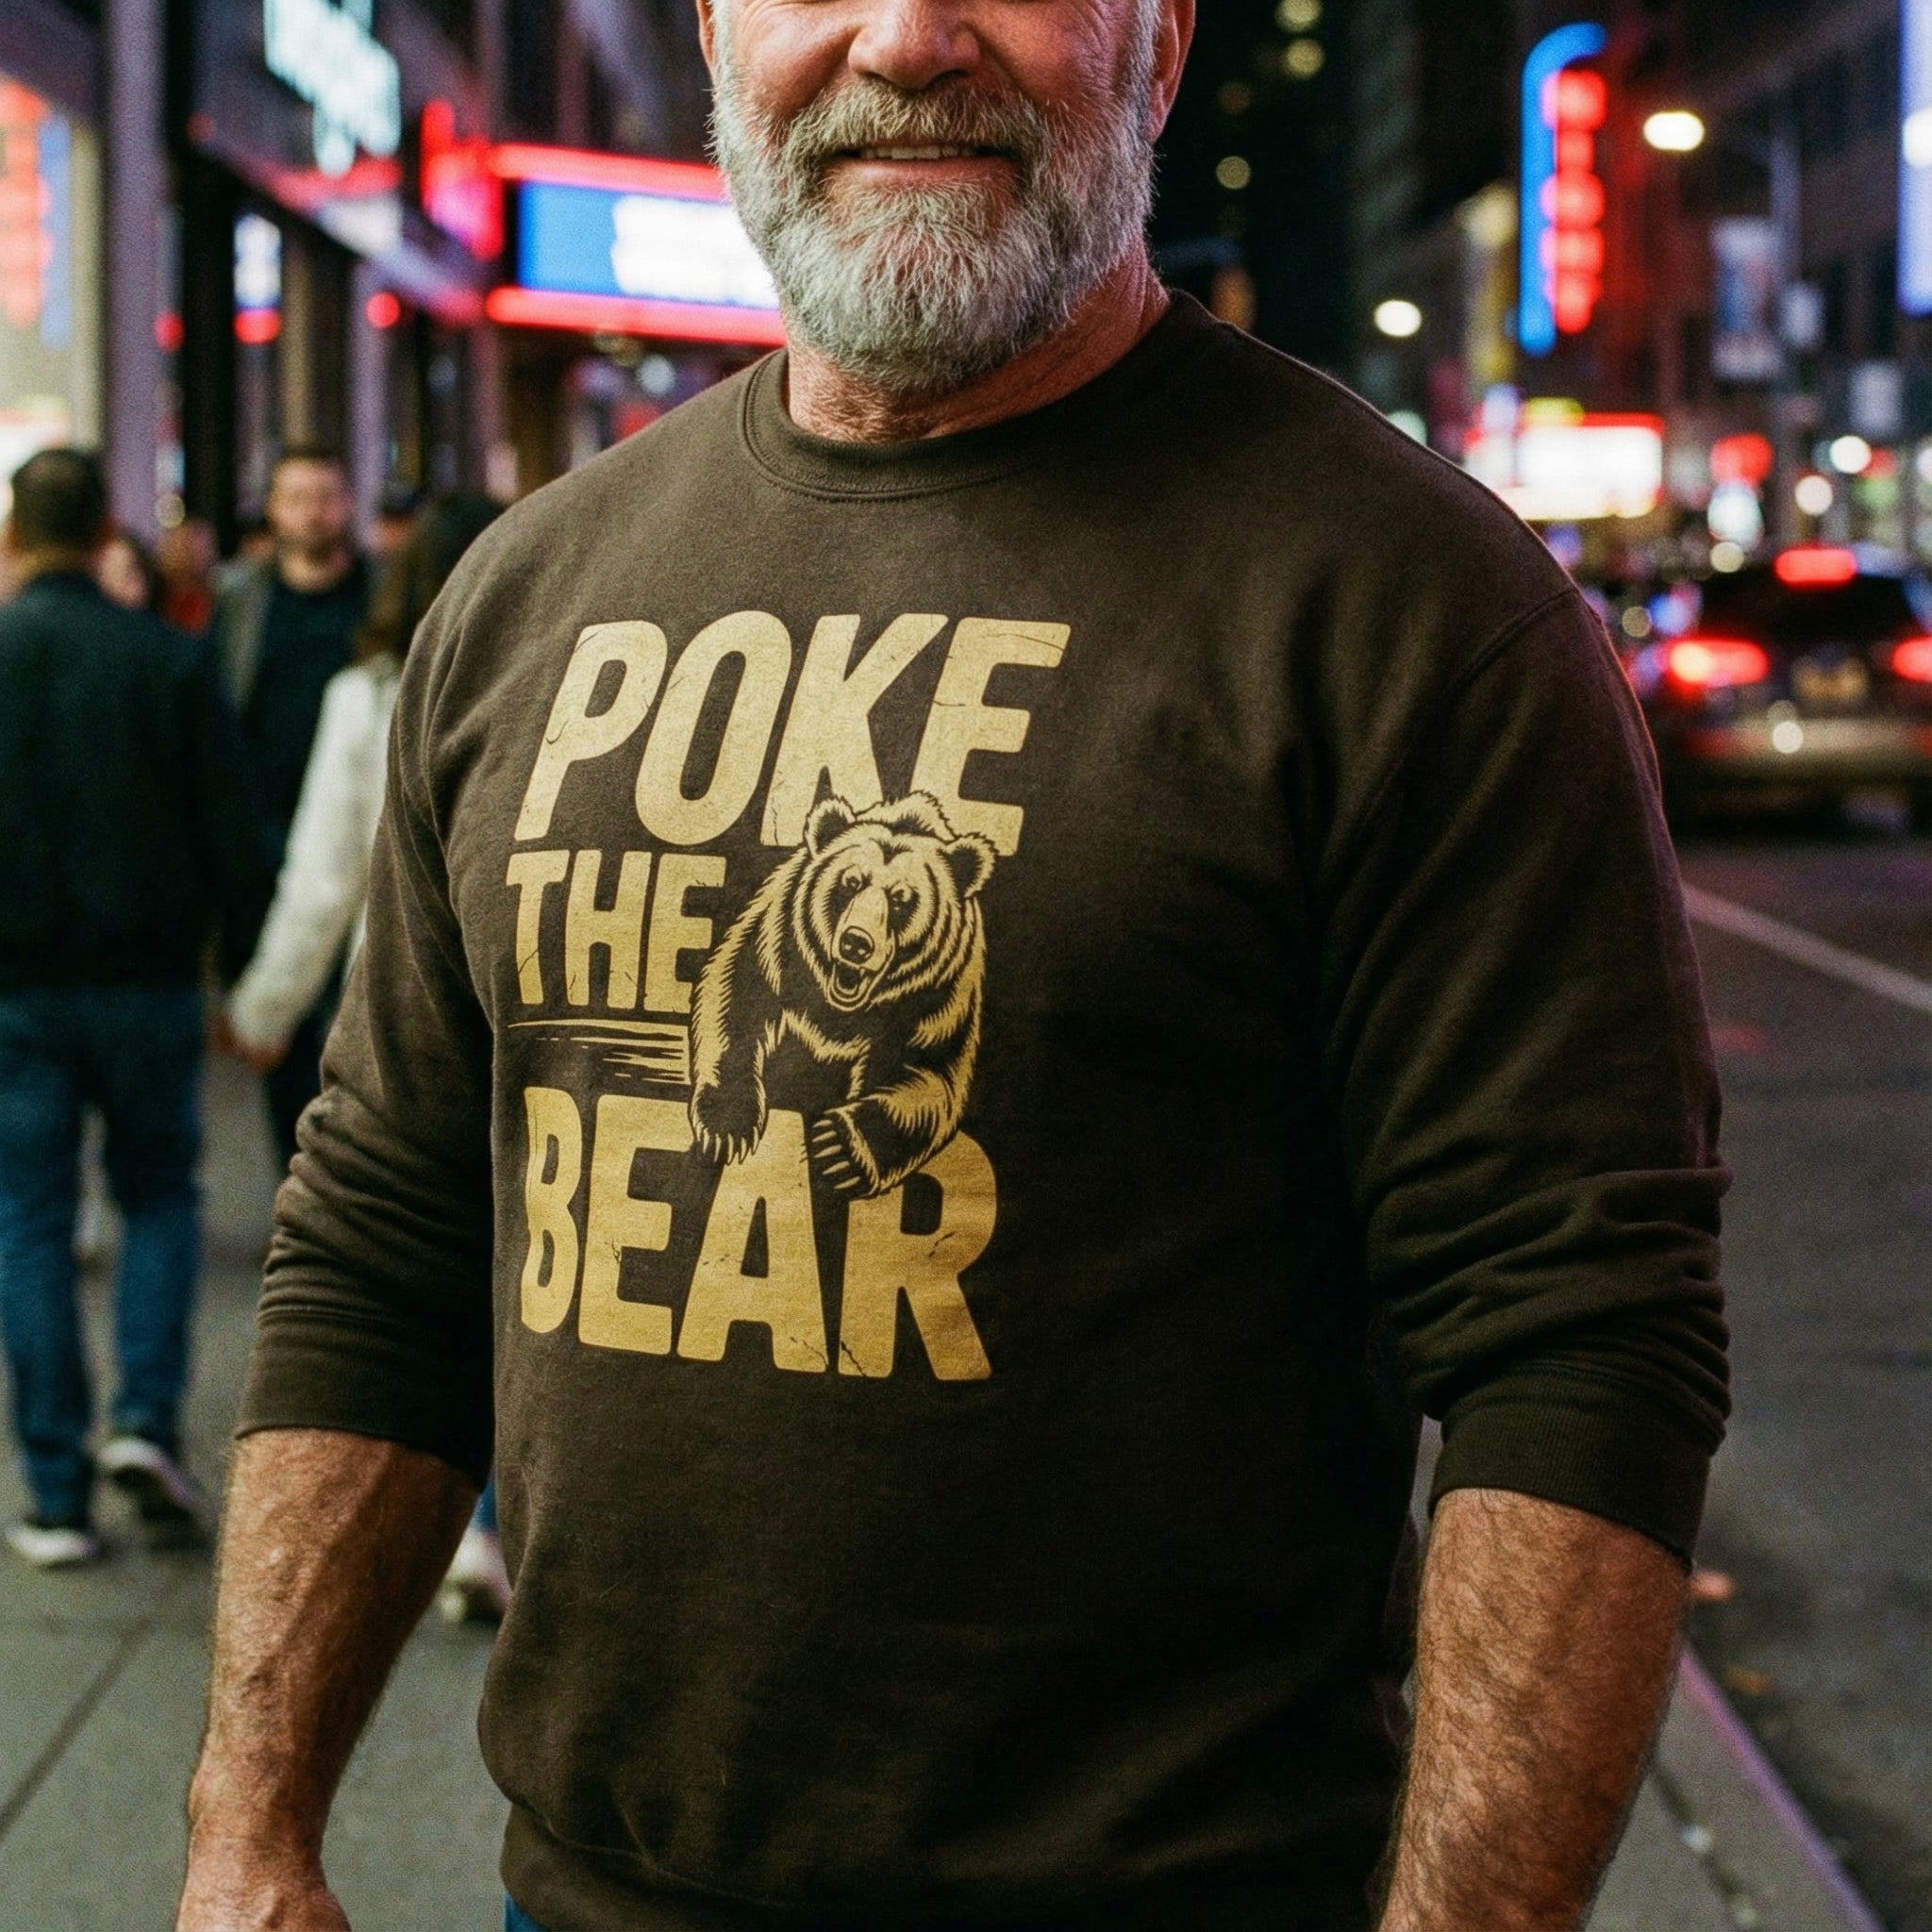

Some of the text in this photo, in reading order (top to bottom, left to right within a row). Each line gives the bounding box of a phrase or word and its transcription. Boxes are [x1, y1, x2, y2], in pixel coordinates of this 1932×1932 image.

[514, 609, 1071, 857] POKE
[507, 849, 726, 1014] THE
[521, 1086, 997, 1381] BEAR
